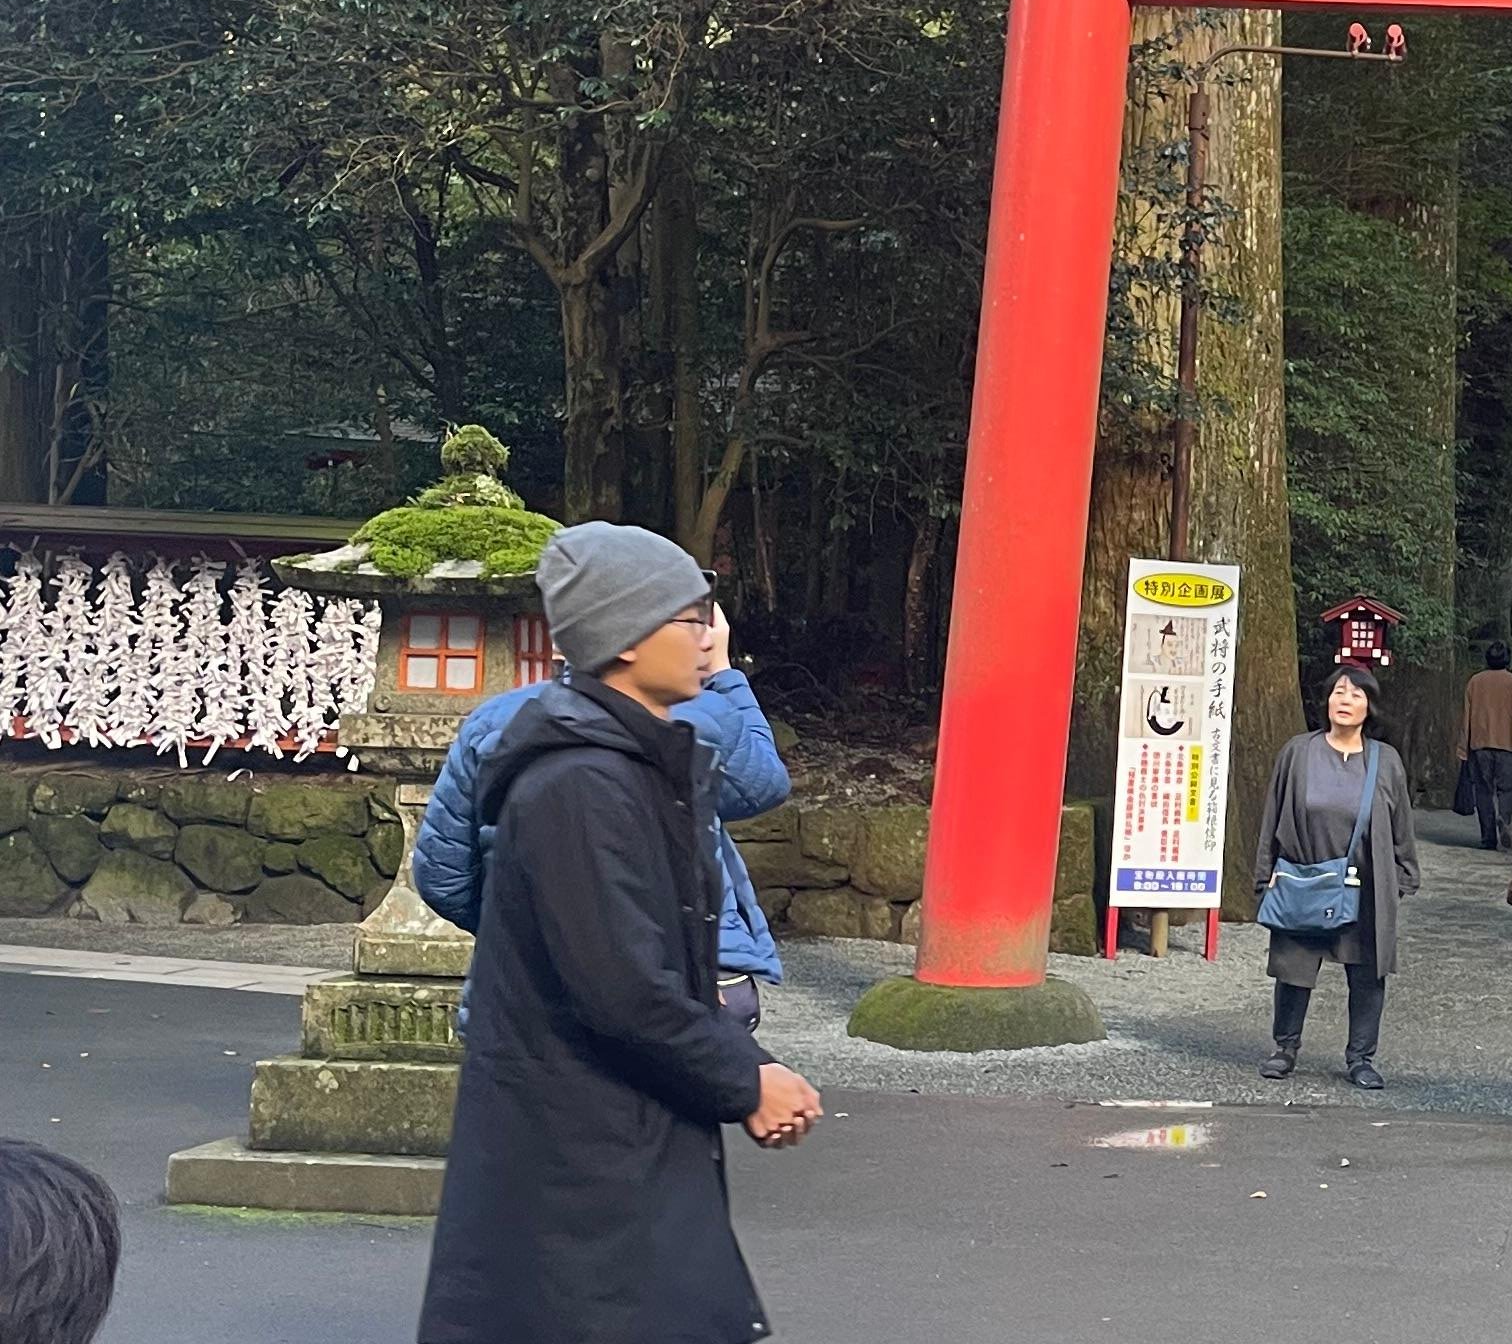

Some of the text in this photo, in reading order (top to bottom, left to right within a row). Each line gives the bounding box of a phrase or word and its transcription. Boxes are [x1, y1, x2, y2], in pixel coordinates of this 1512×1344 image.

[1144, 579, 1225, 600] 特別企画展
[1208, 616, 1231, 720] 武将の手紙
